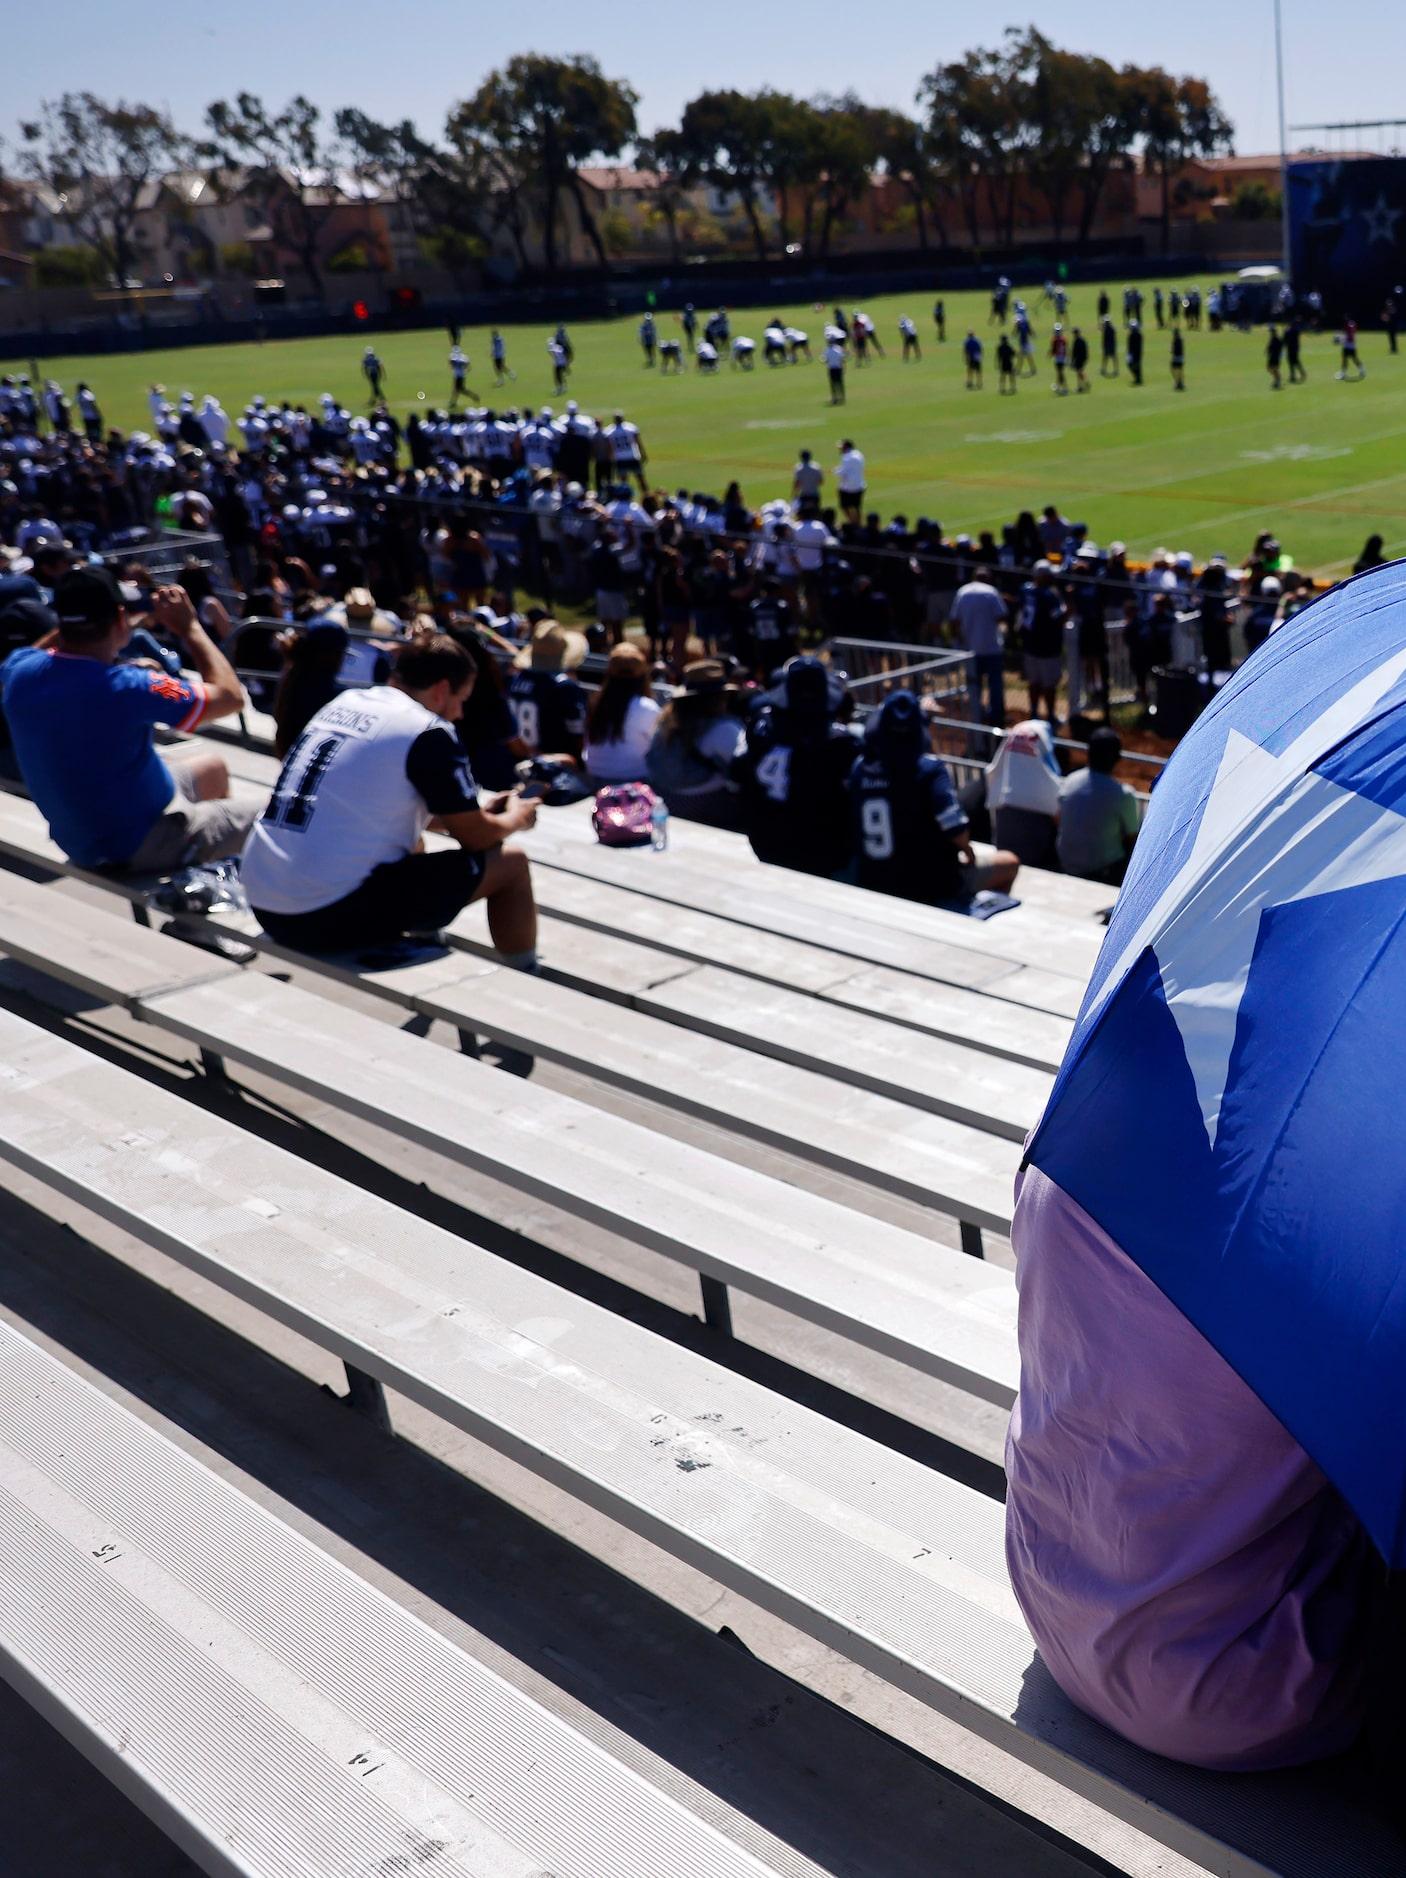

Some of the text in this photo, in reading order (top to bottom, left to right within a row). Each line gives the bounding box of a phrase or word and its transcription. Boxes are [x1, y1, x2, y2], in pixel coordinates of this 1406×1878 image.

[260, 727, 347, 833] 11
[755, 745, 793, 800] 4
[862, 797, 894, 859] 9
